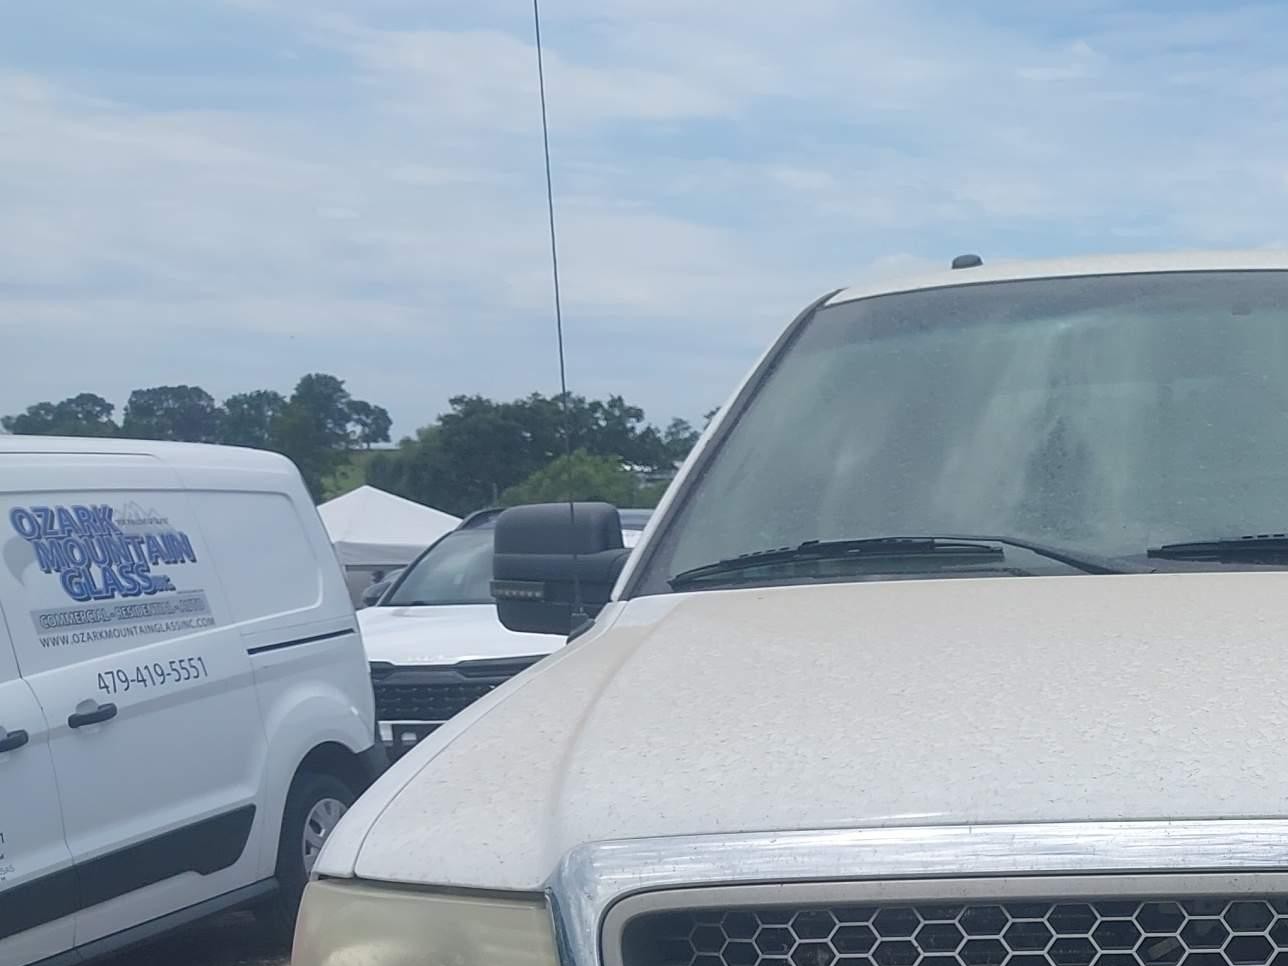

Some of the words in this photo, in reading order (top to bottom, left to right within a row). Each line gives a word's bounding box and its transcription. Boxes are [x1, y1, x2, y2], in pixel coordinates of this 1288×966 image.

[9, 504, 123, 540] OZARK
[33, 531, 197, 574] MOUNTAIN
[60, 562, 158, 602] GLASS
[40, 608, 112, 629] COMMERCIAL
[97, 656, 209, 695] 479-419-5551
